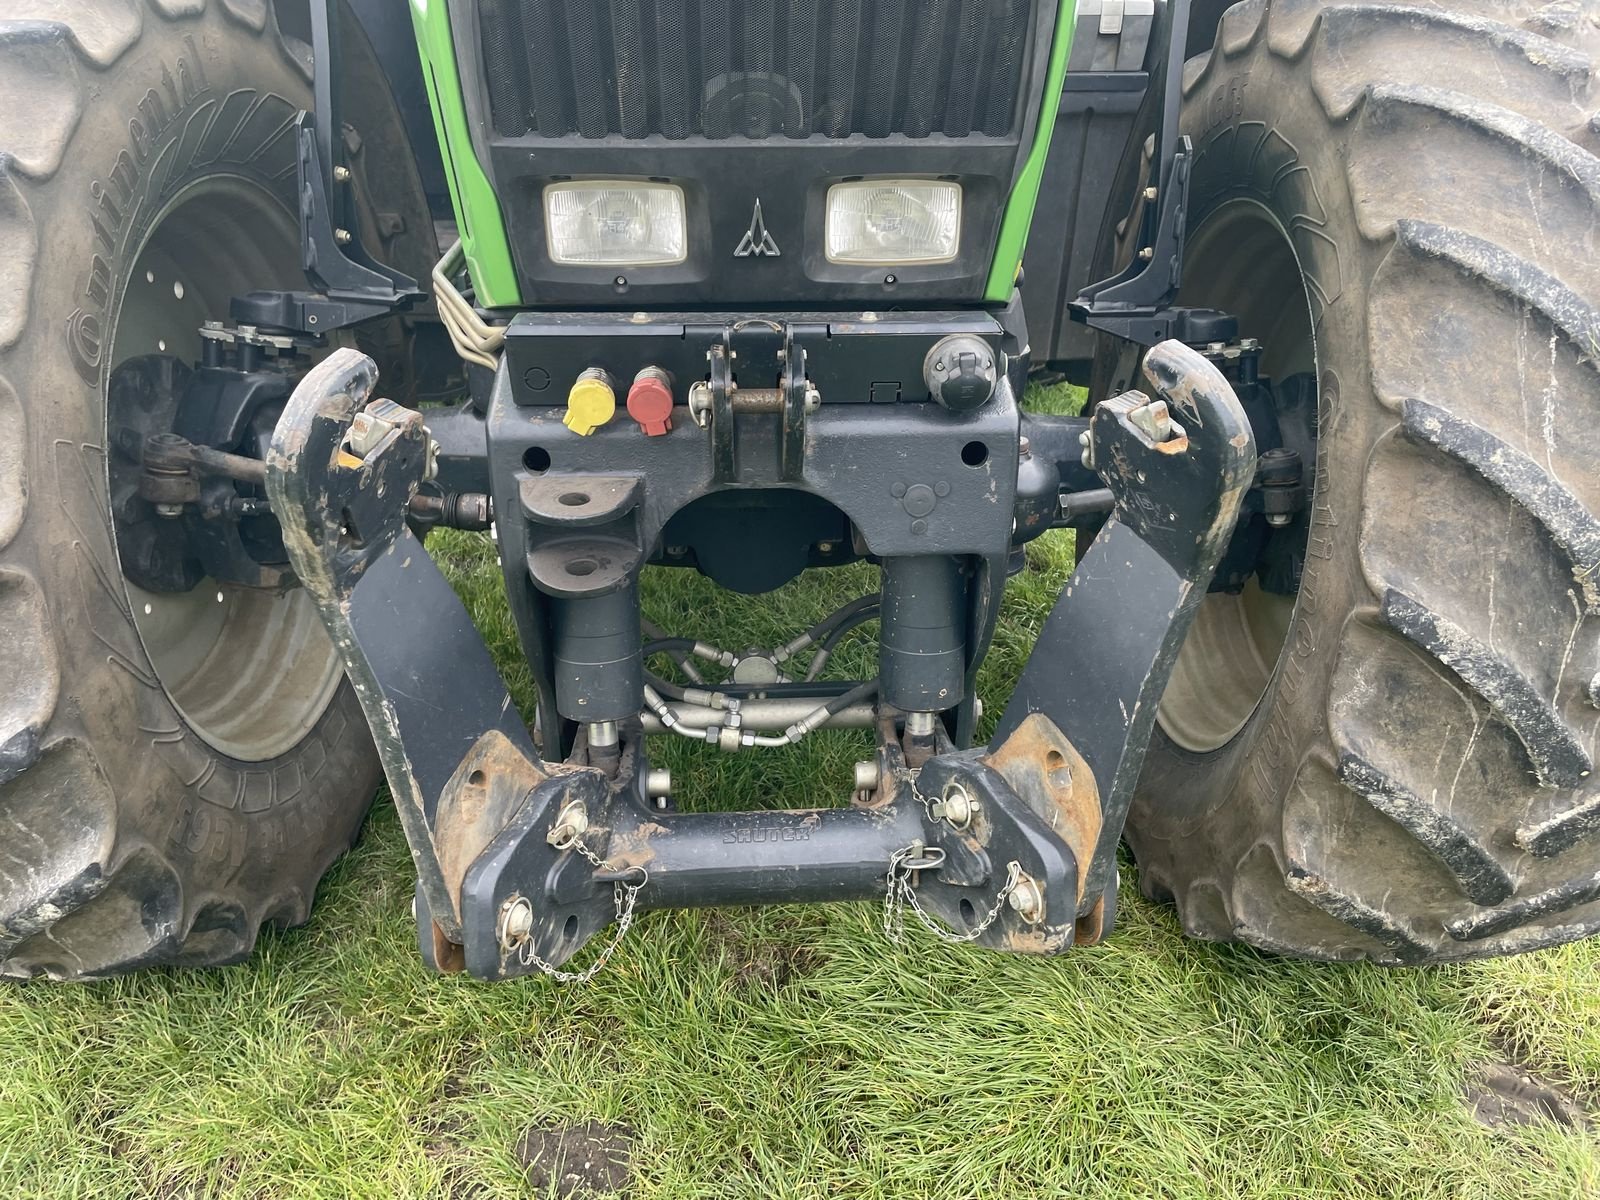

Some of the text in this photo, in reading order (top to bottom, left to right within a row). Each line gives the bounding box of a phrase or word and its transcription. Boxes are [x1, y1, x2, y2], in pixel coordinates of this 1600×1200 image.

[66, 33, 211, 388] Continental
[1251, 367, 1344, 802] Continental
[723, 827, 810, 844] SAUTER
